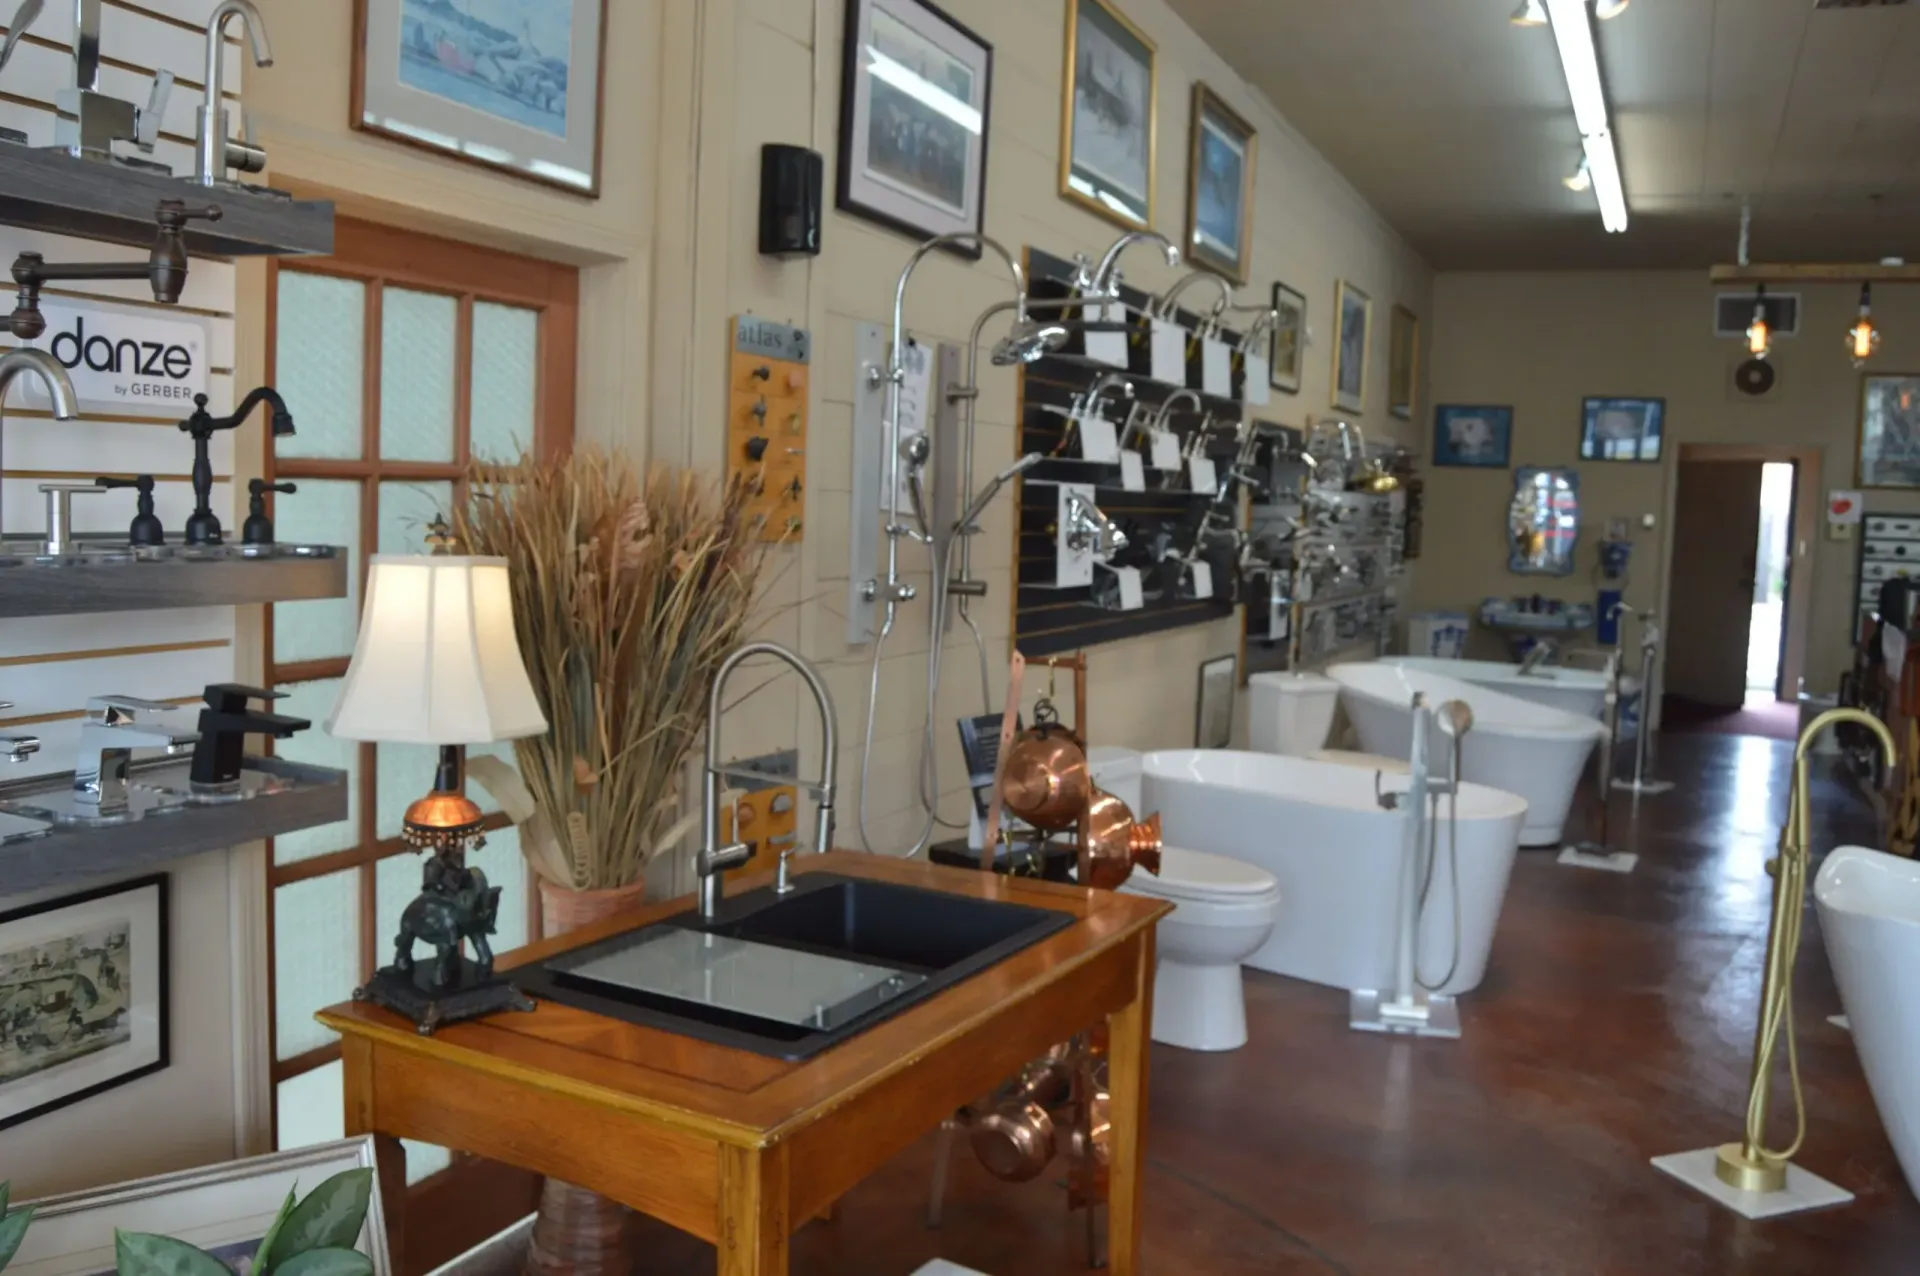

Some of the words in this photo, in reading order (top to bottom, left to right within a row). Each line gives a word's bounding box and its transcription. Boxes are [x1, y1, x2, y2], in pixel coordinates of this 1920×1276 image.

[51, 316, 192, 379] danze
[737, 322, 783, 348] atlas
[114, 384, 128, 396] by
[131, 383, 192, 399] GERBER
